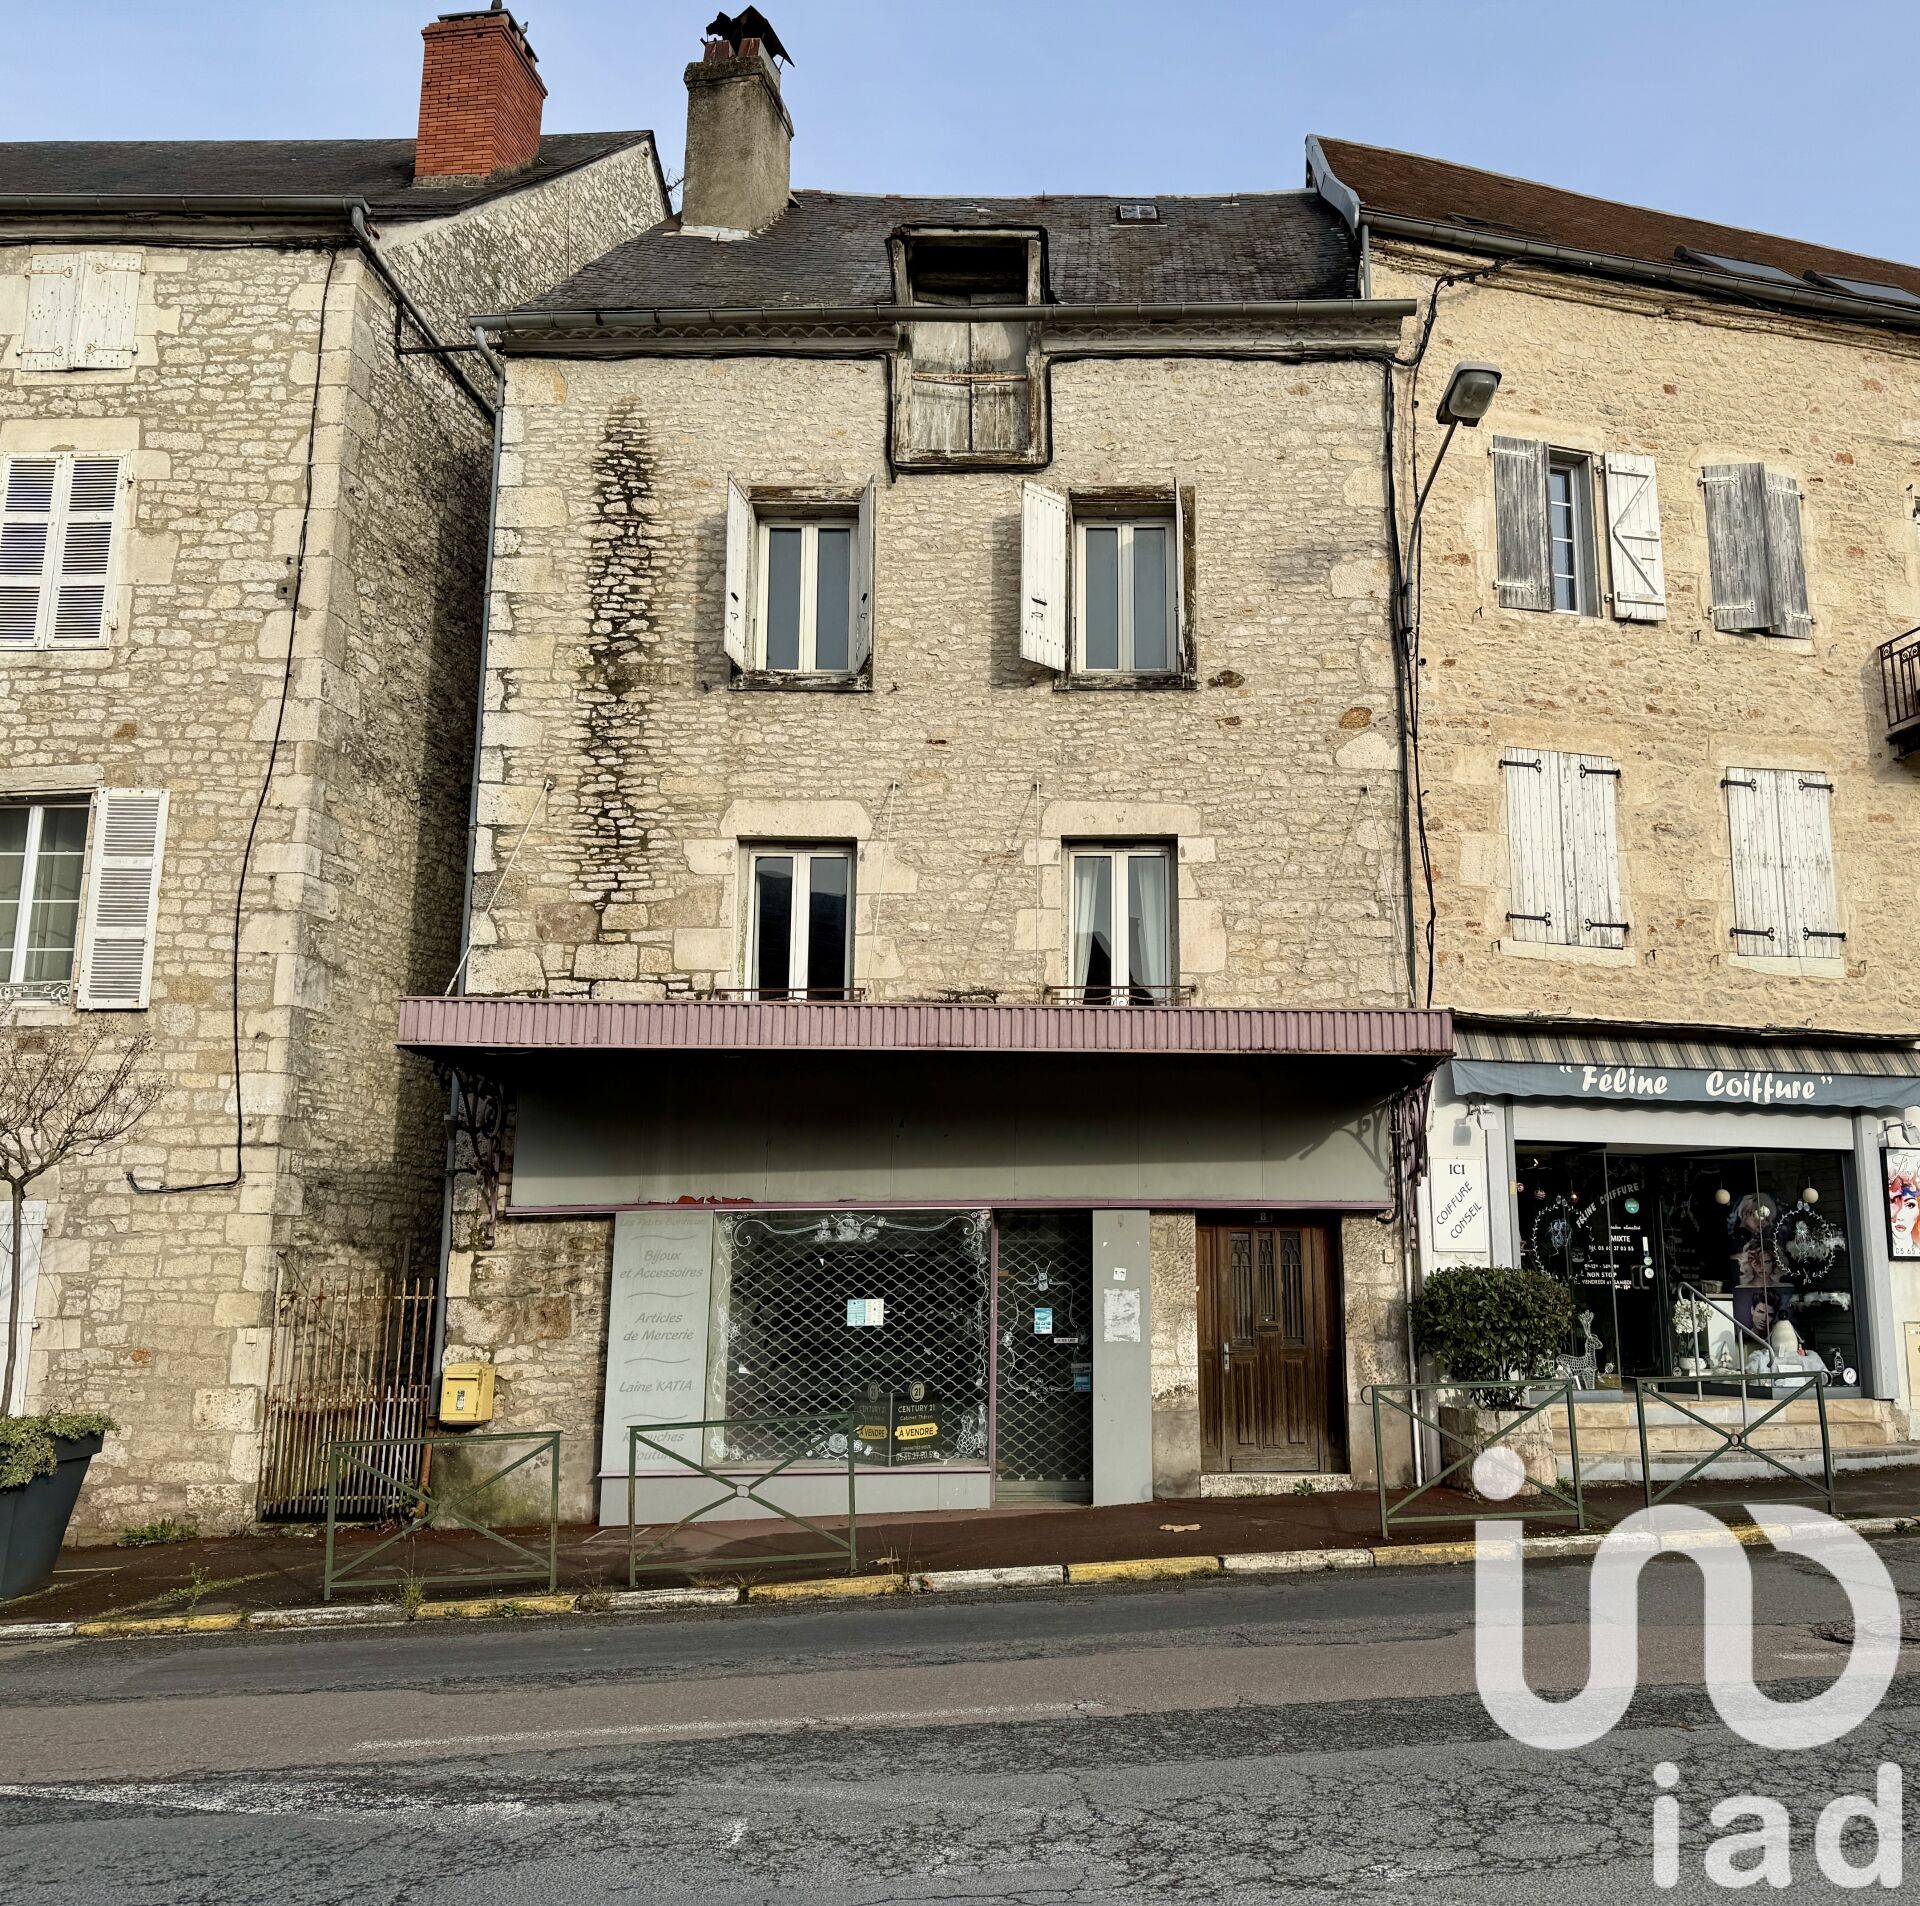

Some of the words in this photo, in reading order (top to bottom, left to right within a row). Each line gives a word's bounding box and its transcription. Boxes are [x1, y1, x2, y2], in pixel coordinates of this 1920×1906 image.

[1449, 1164, 1465, 1175] ICI
[1436, 1180, 1473, 1225] COIFFURE
[1450, 1202, 1483, 1239] CONSEIL
[1610, 1235, 1631, 1243] MIXTE
[644, 1250, 682, 1264] Bijoux
[1895, 1247, 1904, 1255] 05
[620, 1268, 632, 1279] et
[634, 1266, 704, 1278] Accessoires
[634, 1312, 684, 1324] Articles
[623, 1330, 639, 1341] de
[642, 1328, 695, 1341] Mercerie
[619, 1380, 653, 1393] Laine
[655, 1380, 694, 1392] KATIA
[898, 1404, 927, 1414] CENTURY
[929, 1403, 936, 1411] 21
[622, 1431, 685, 1442] Rouches
[905, 1426, 934, 1437] VENDRE
